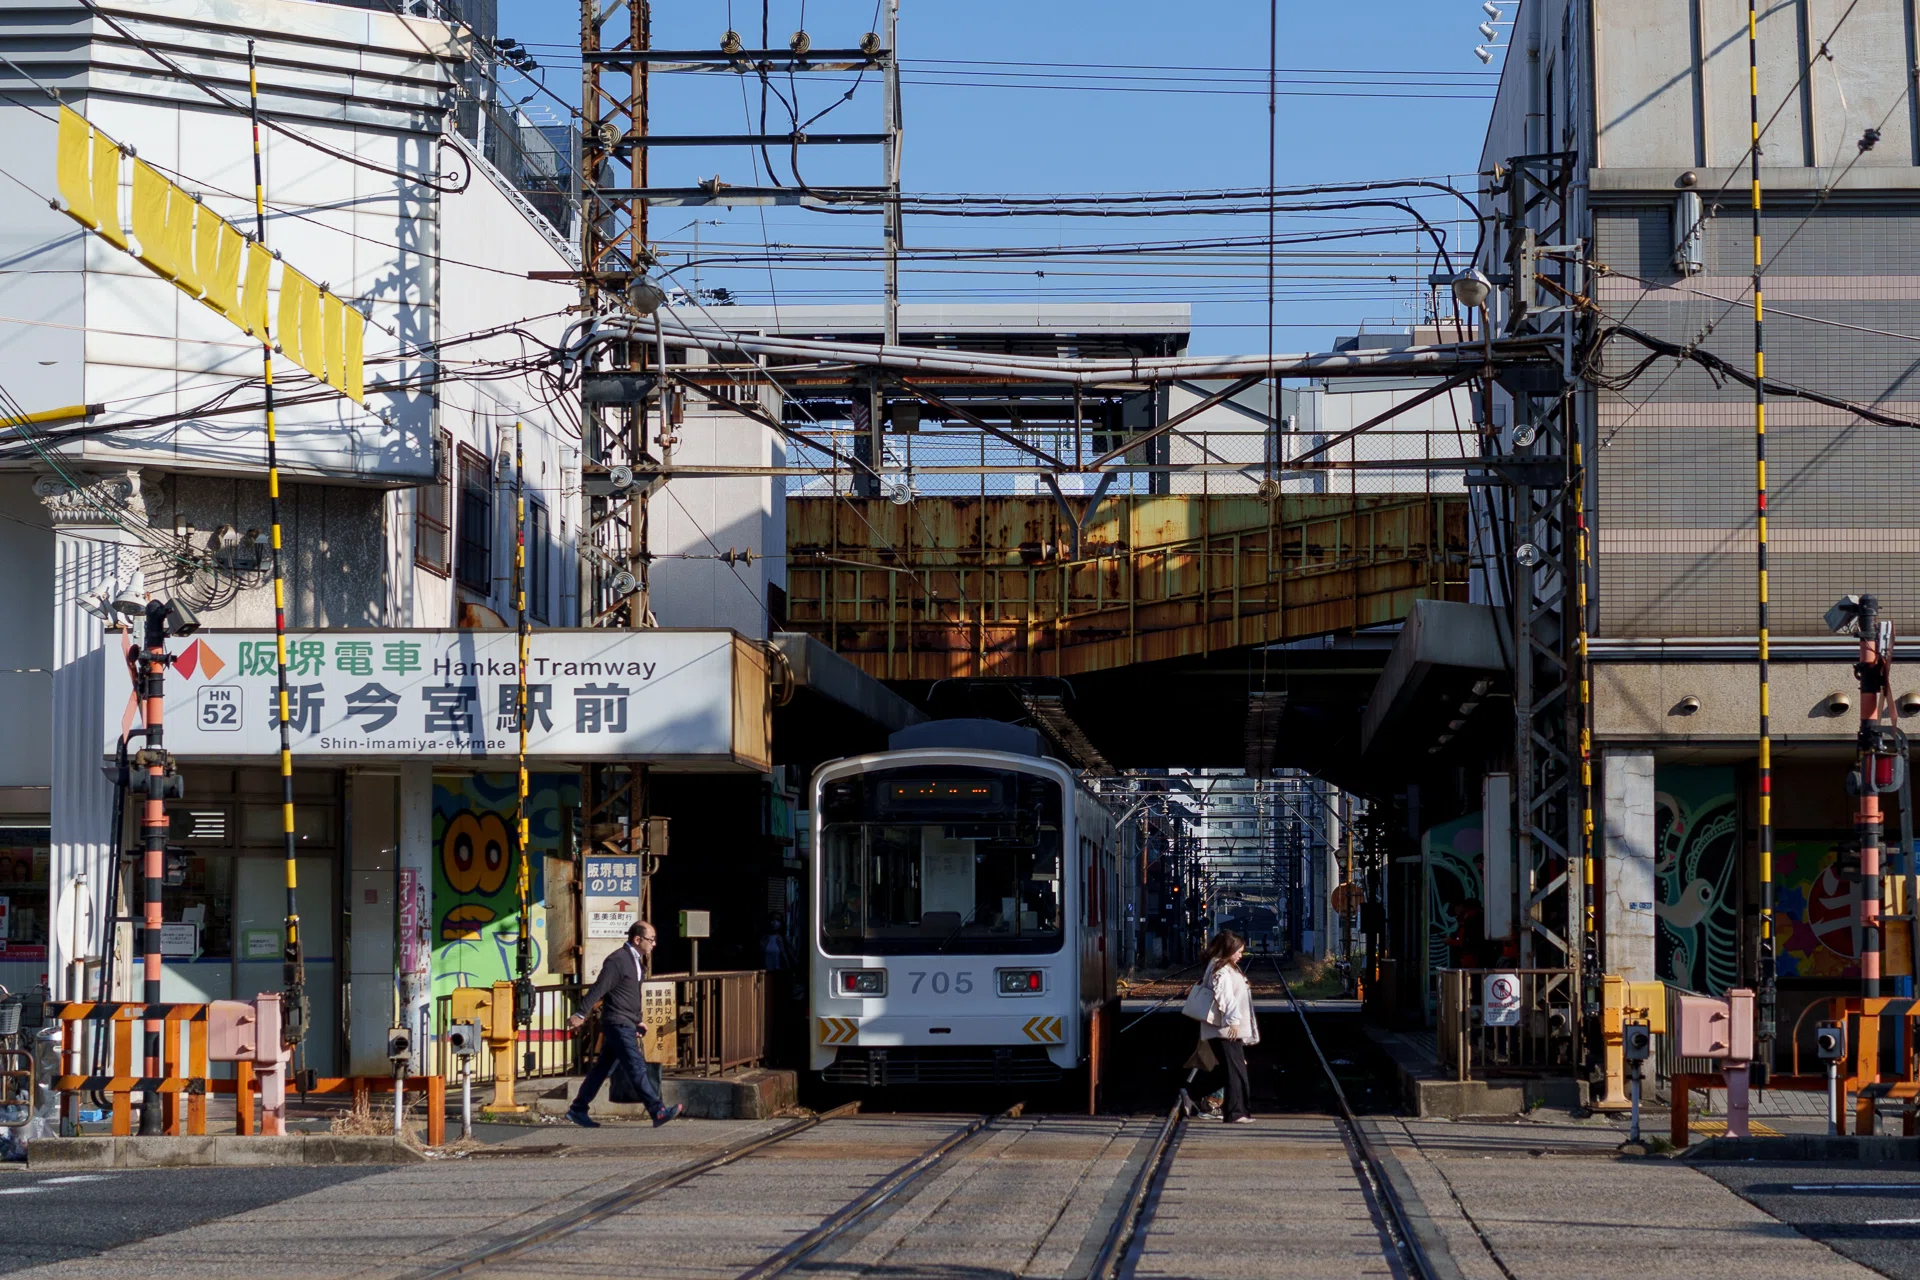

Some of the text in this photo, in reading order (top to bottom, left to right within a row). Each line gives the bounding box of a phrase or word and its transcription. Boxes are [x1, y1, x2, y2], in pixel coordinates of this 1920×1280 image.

[238, 640, 422, 677] 阪堺電車
[433, 657, 657, 681] Hanka Tramway
[209, 690, 231, 701] HN
[202, 703, 238, 725] 52
[267, 682, 631, 734] 新今宮駅前
[320, 736, 506, 751] Shin-imamiya-ekimae
[587, 862, 637, 878] 阪堺電車
[591, 878, 633, 892] のりば
[400, 872, 413, 970] コインロッカー
[592, 912, 633, 921] 恵美須町行
[908, 971, 974, 995] 705
